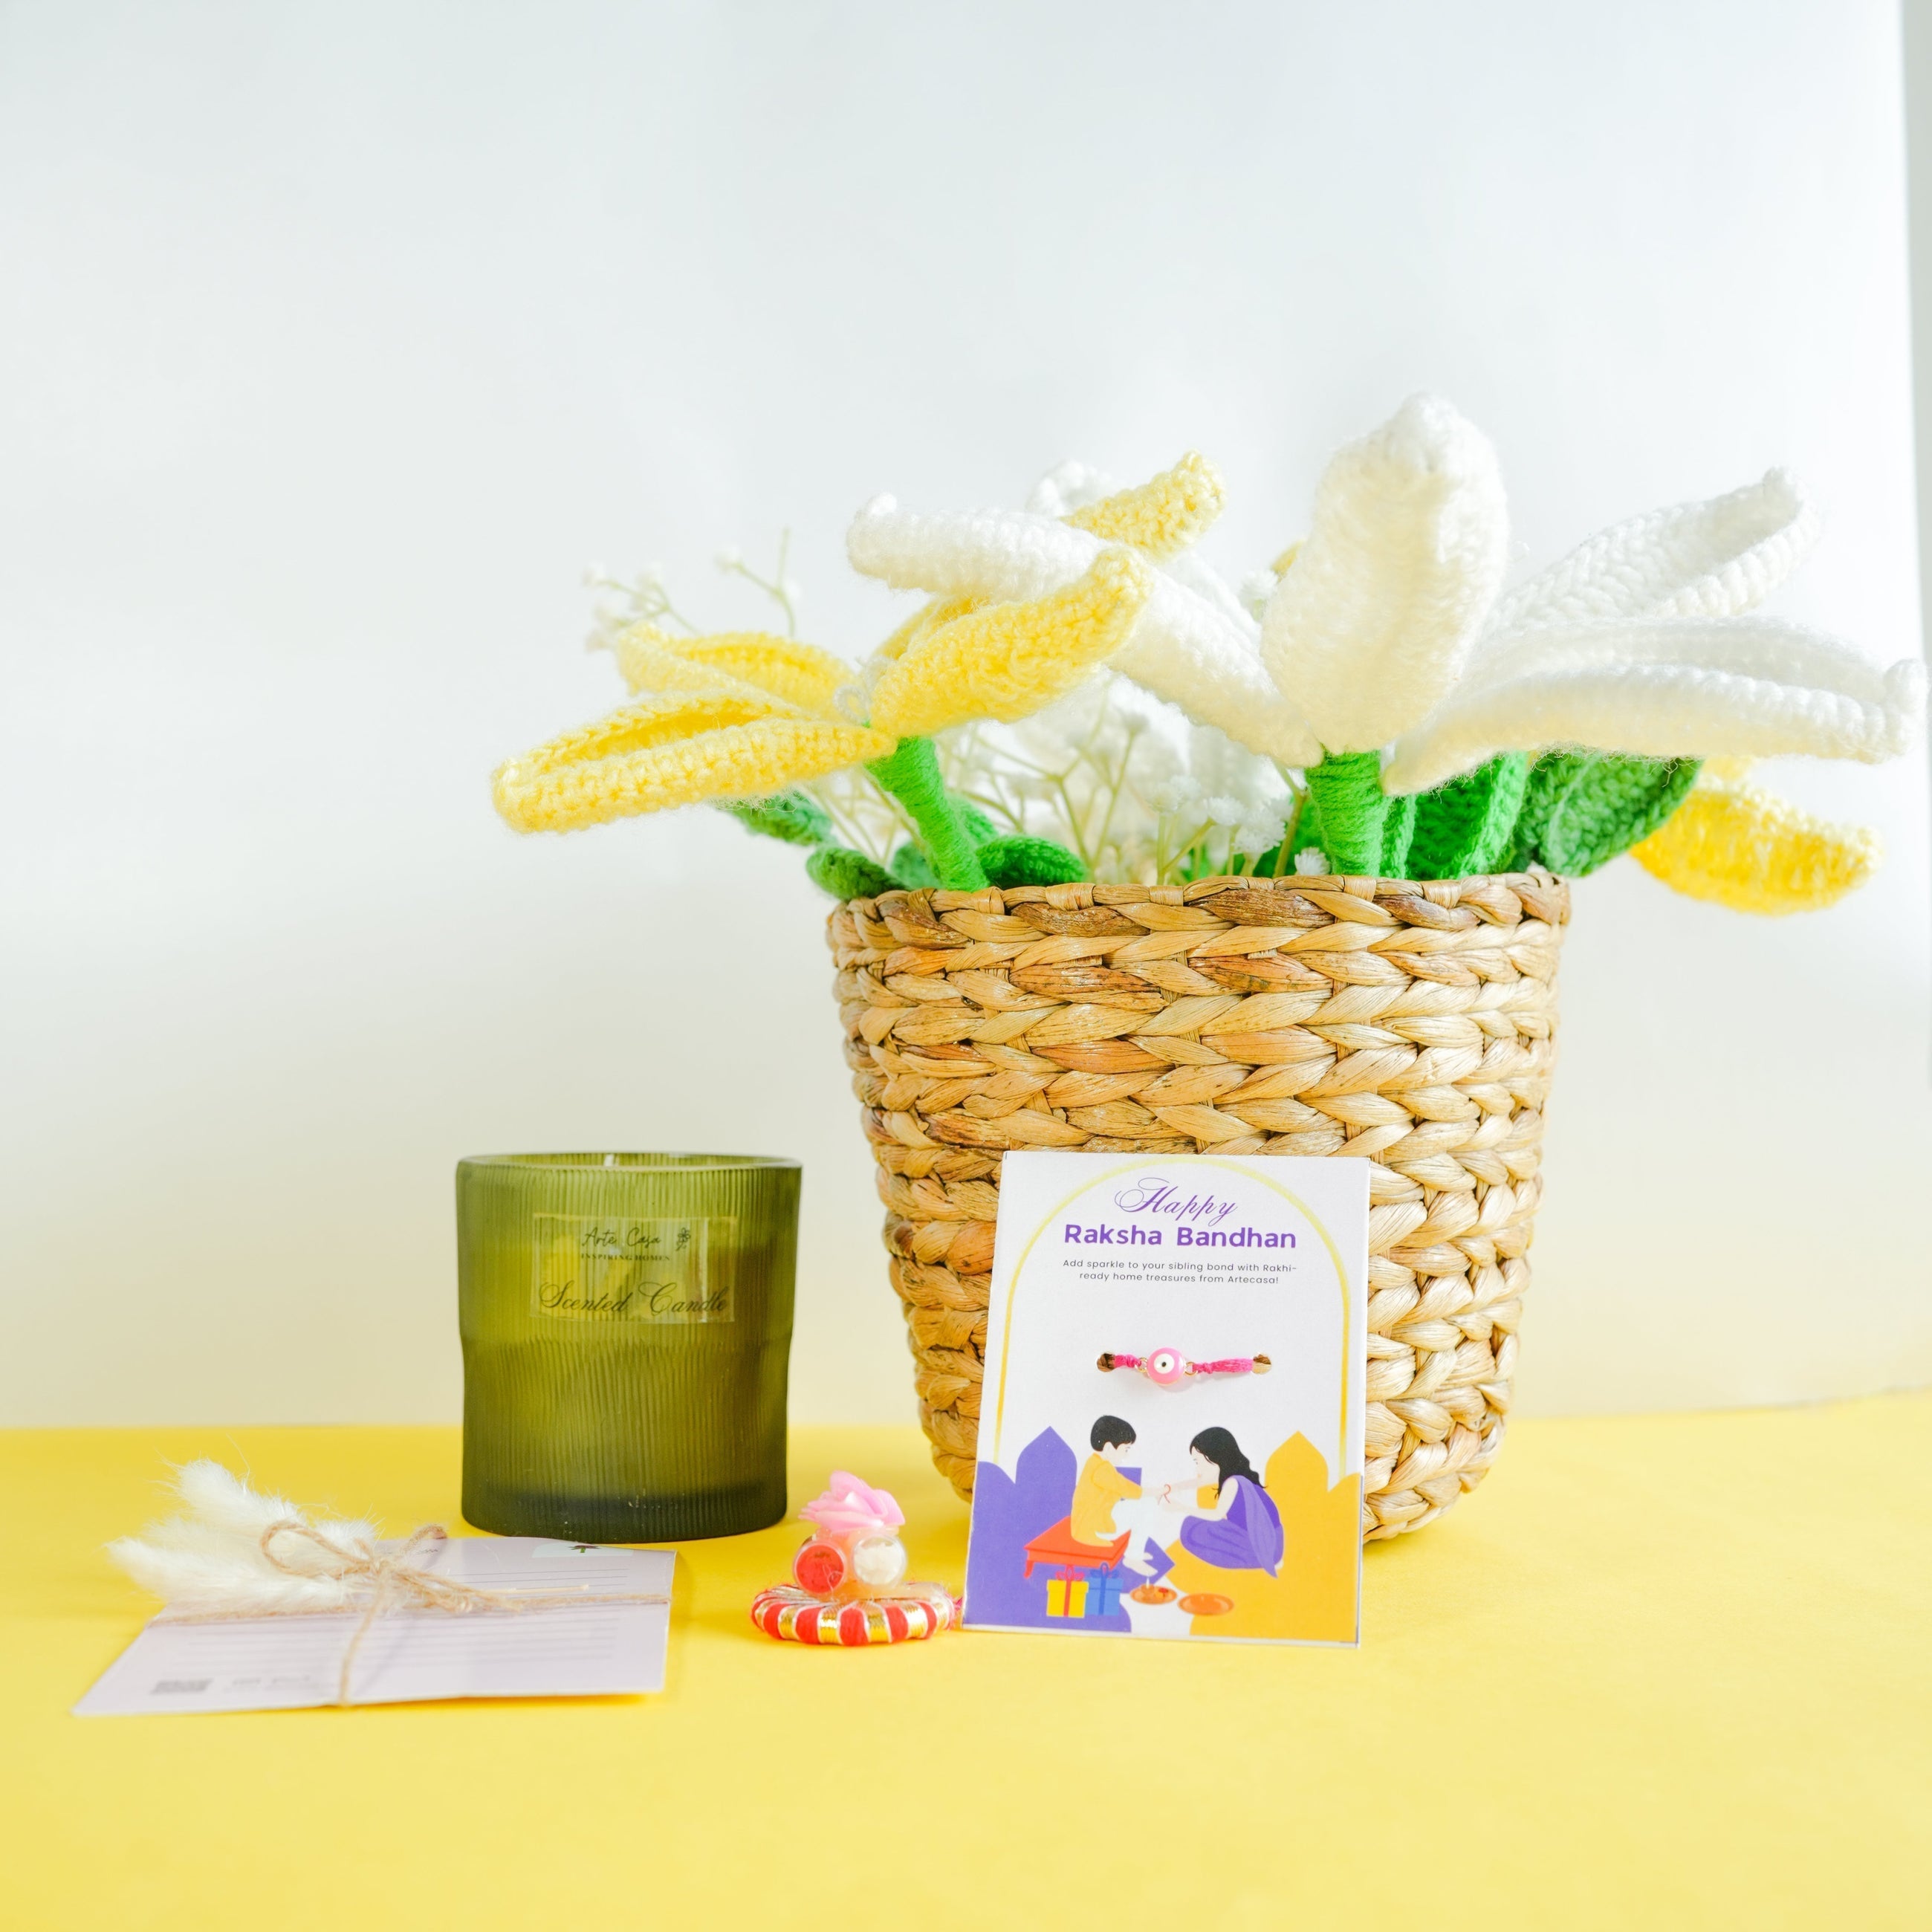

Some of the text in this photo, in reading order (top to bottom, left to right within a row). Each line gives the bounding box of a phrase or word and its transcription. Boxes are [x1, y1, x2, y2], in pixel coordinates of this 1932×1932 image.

[1115, 1177, 1237, 1227] Happy
[582, 1226, 661, 1248] Arte Casa
[1064, 1224, 1297, 1248] Raksha Bandhan
[1080, 1271, 1280, 1284] ready home treasures from Artecasa!
[1087, 1260, 1124, 1271] sparkle
[1128, 1261, 1138, 1269] to
[1142, 1262, 1164, 1271] your
[1168, 1261, 1204, 1272] sibling
[1207, 1262, 1234, 1271] bond
[1237, 1263, 1260, 1271] with
[1262, 1264, 1297, 1272] Rakhi-
[539, 1280, 729, 1316] Scented Candle
